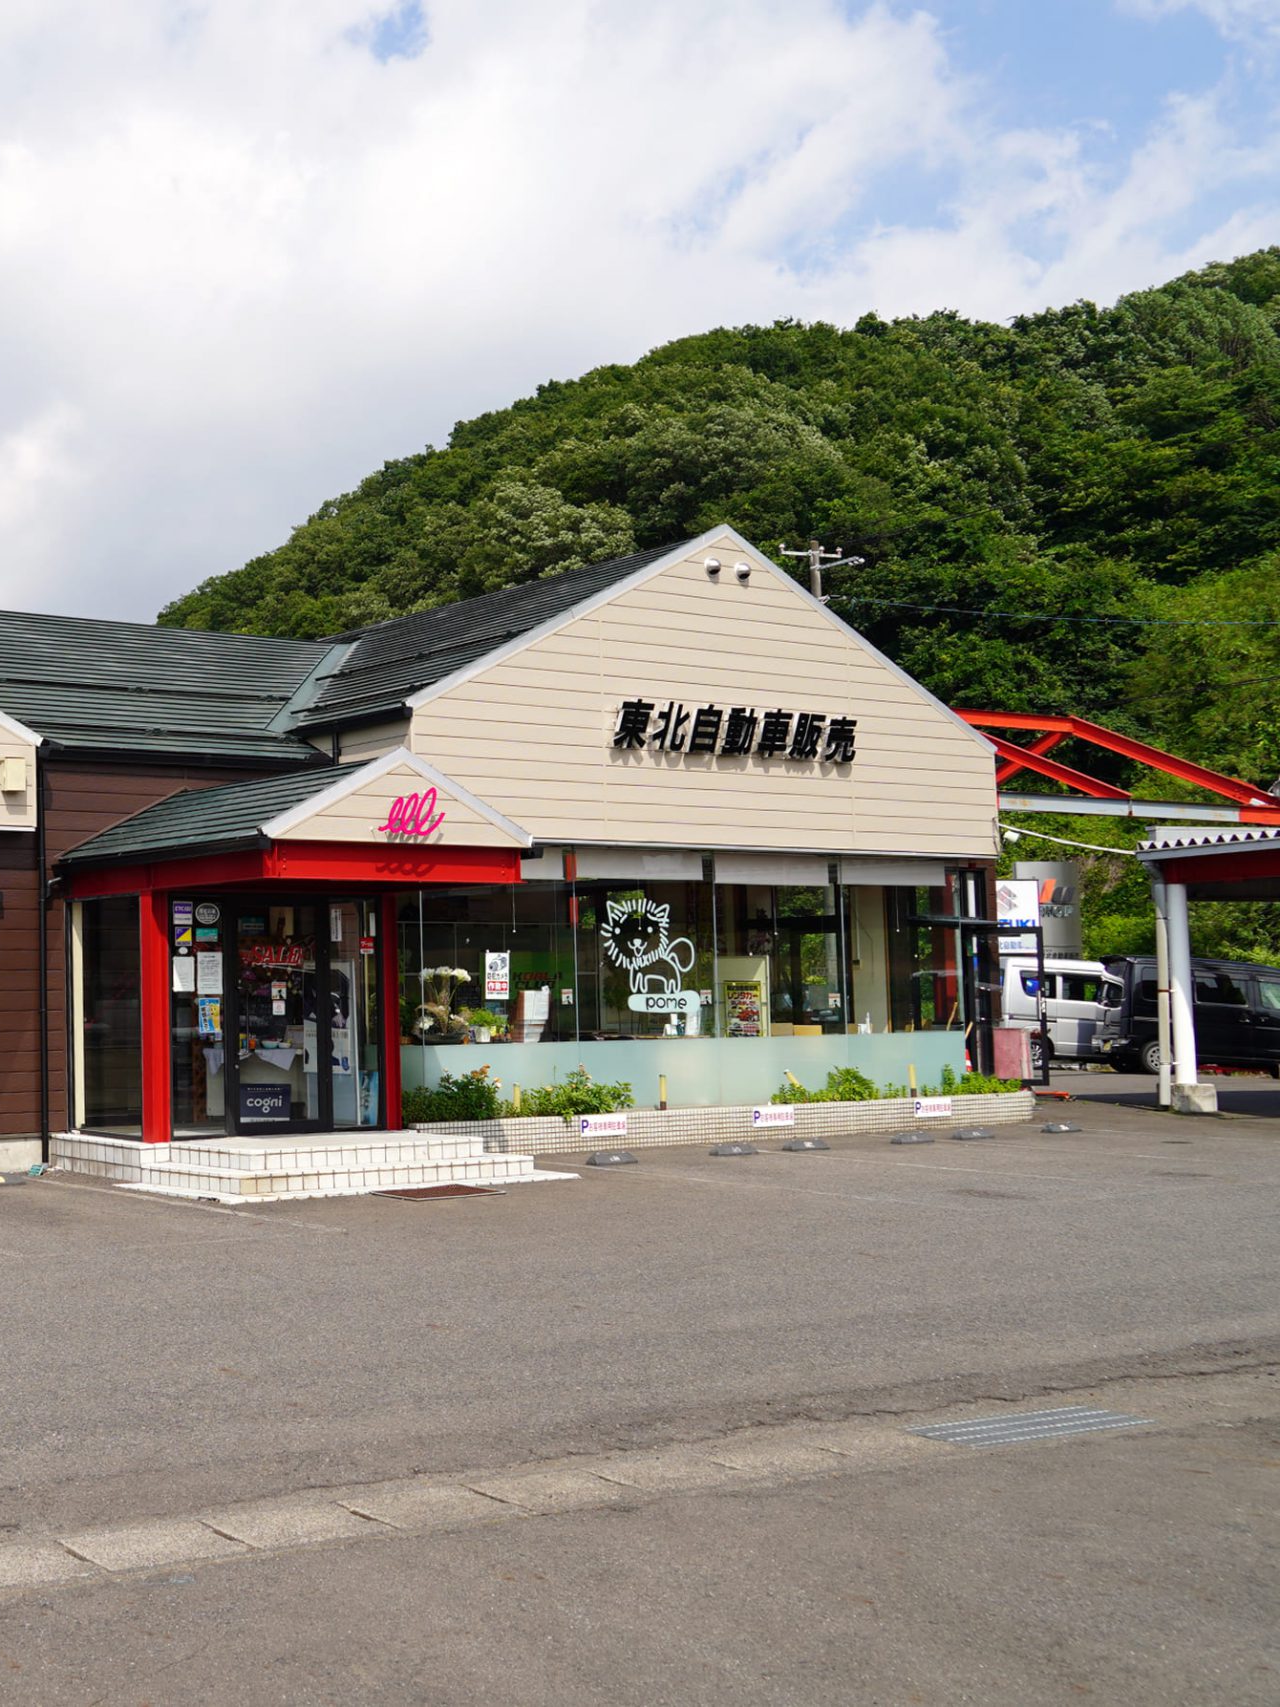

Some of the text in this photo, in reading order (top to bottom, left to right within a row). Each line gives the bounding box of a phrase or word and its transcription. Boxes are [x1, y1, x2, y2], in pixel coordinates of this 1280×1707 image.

[613, 699, 858, 763] 東北自動車販売
[646, 997, 687, 1010] pome
